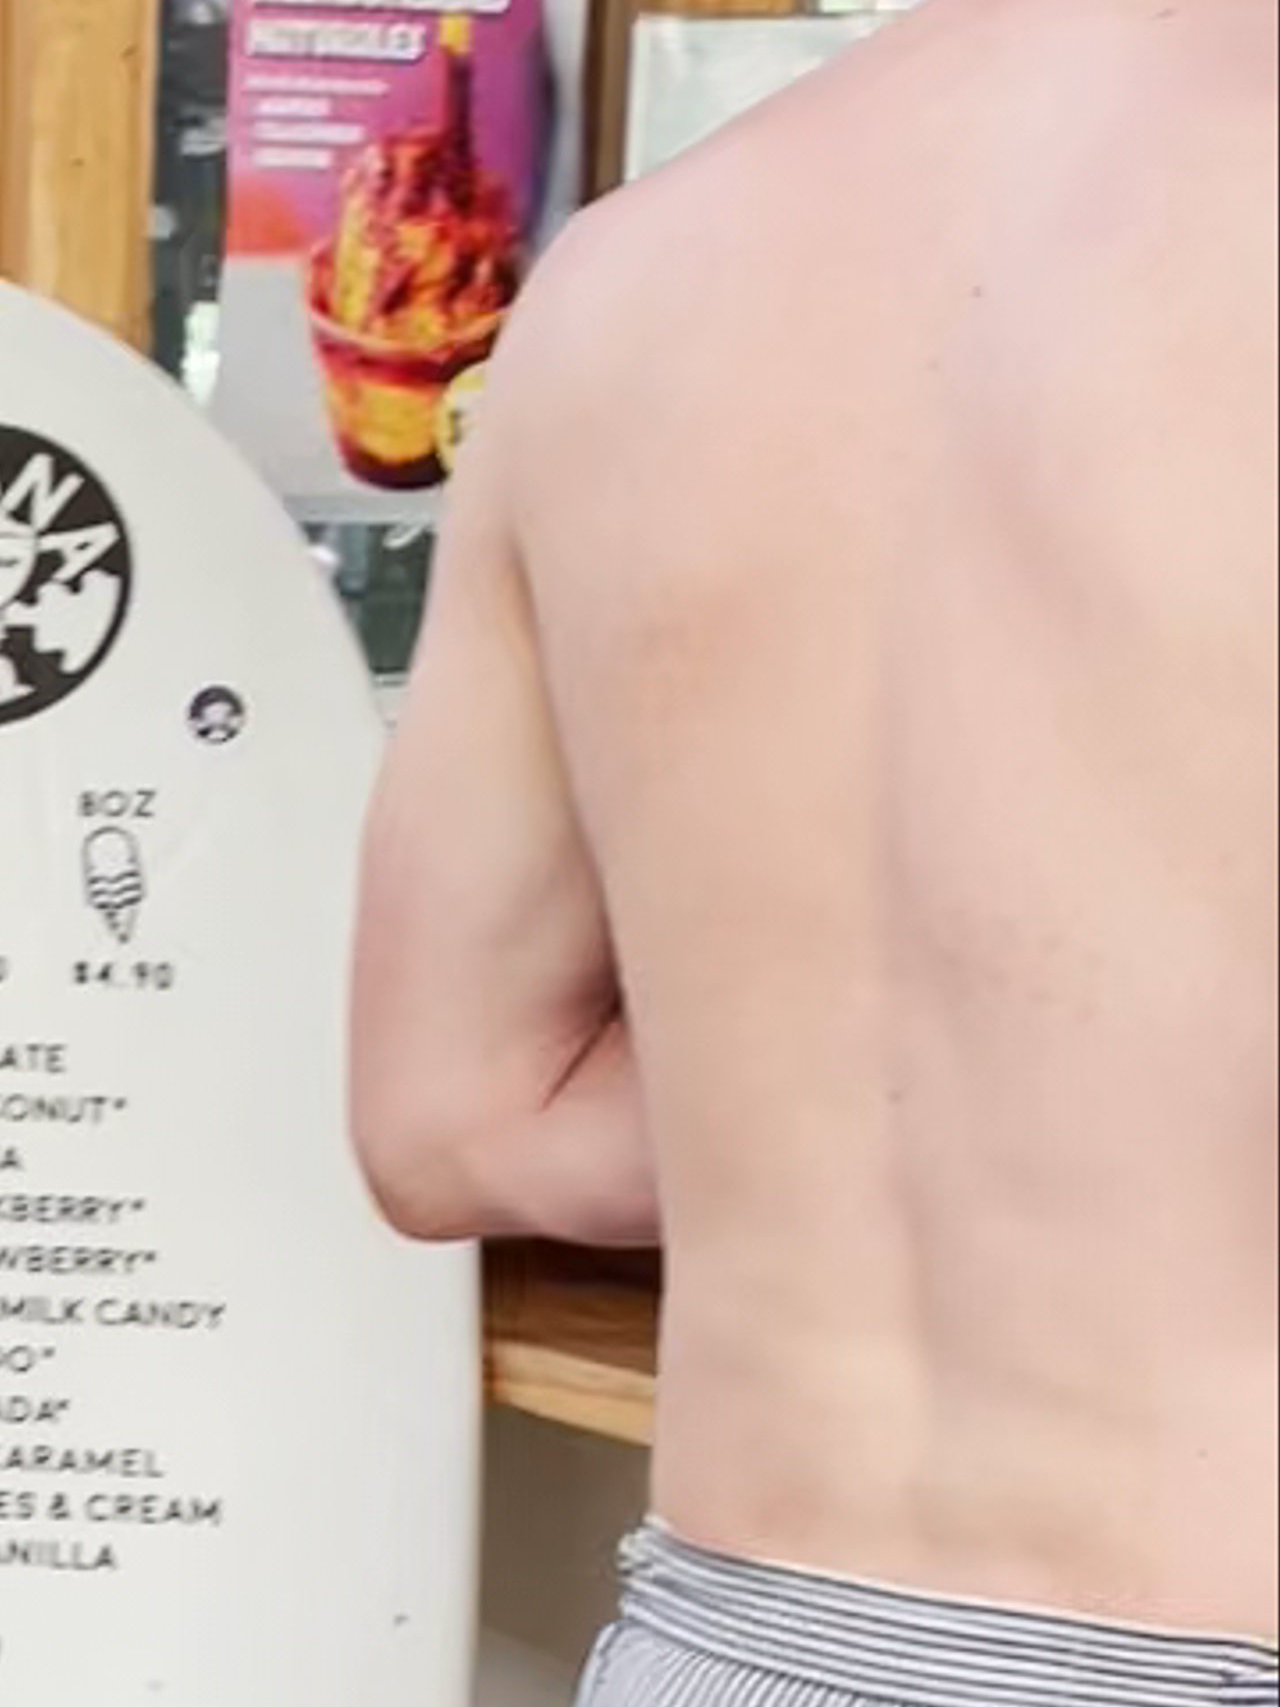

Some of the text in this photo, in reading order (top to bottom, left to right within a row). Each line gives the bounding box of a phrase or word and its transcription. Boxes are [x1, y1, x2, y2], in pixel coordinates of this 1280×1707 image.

[72, 960, 176, 991] $4.90
[93, 1297, 228, 1330] CANDY
[48, 1492, 74, 1520] &
[83, 1493, 223, 1527] CREAM
